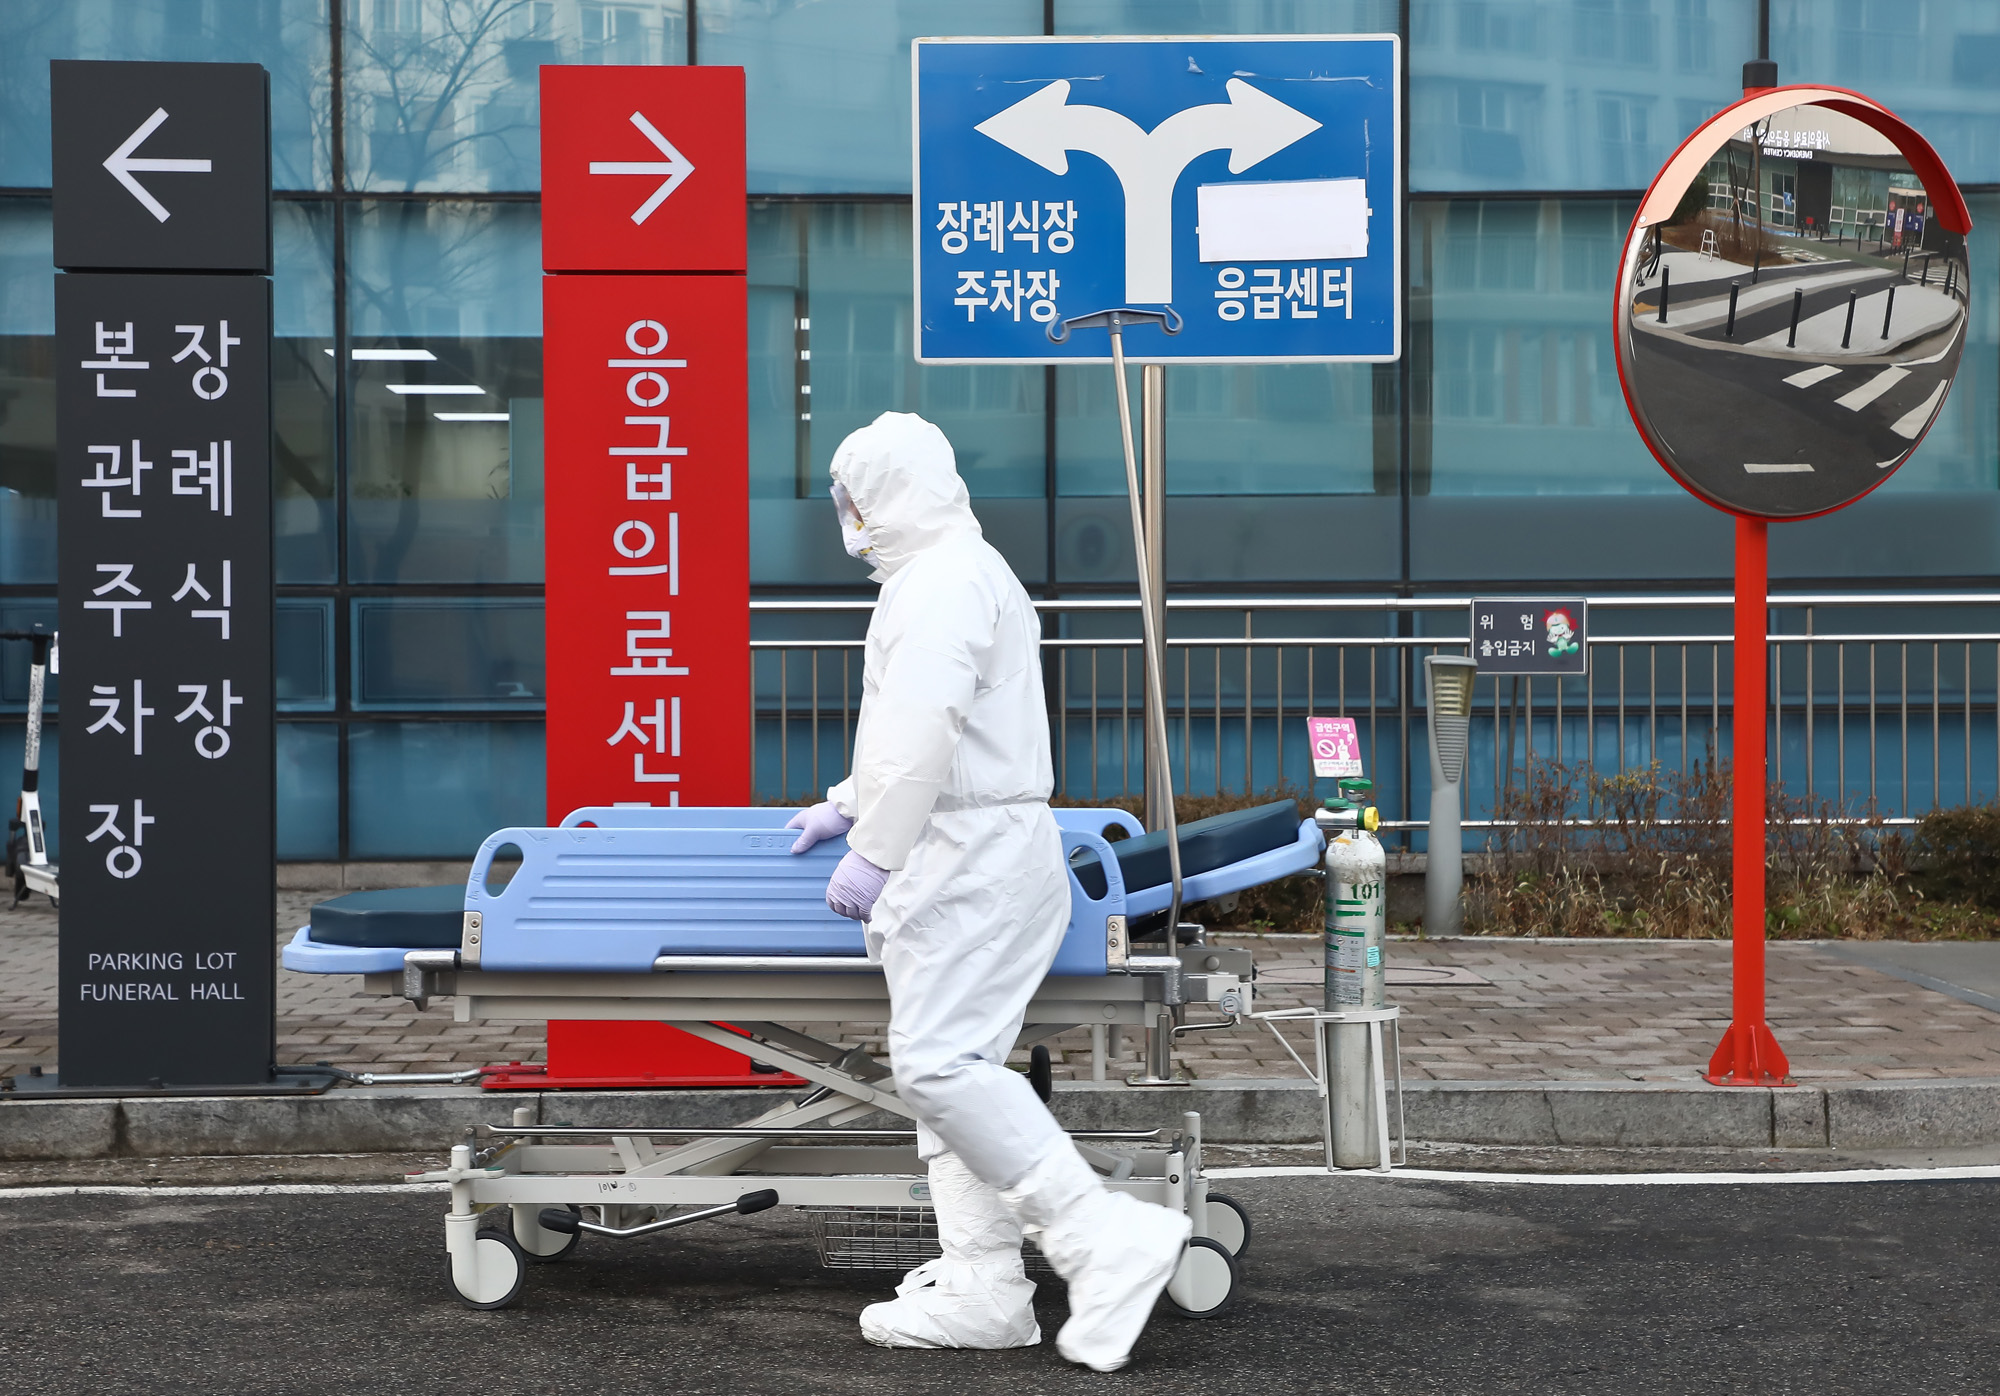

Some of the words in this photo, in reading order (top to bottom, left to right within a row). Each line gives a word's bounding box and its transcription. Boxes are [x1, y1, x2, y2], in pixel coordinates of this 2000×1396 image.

[936, 200, 1078, 254] 장례식장
[954, 269, 1060, 322] 주차장
[1214, 266, 1353, 321] 응급센터
[171, 320, 244, 759] 장례식장
[607, 319, 690, 807] 응급의료센
[1479, 613, 1494, 630] 위
[1520, 613, 1534, 631] 험
[1479, 639, 1535, 657] 출입금지
[88, 952, 183, 970] PARKING
[196, 952, 238, 970] LOT
[80, 983, 179, 1001] FUNERAL
[191, 982, 246, 1000] HALL
